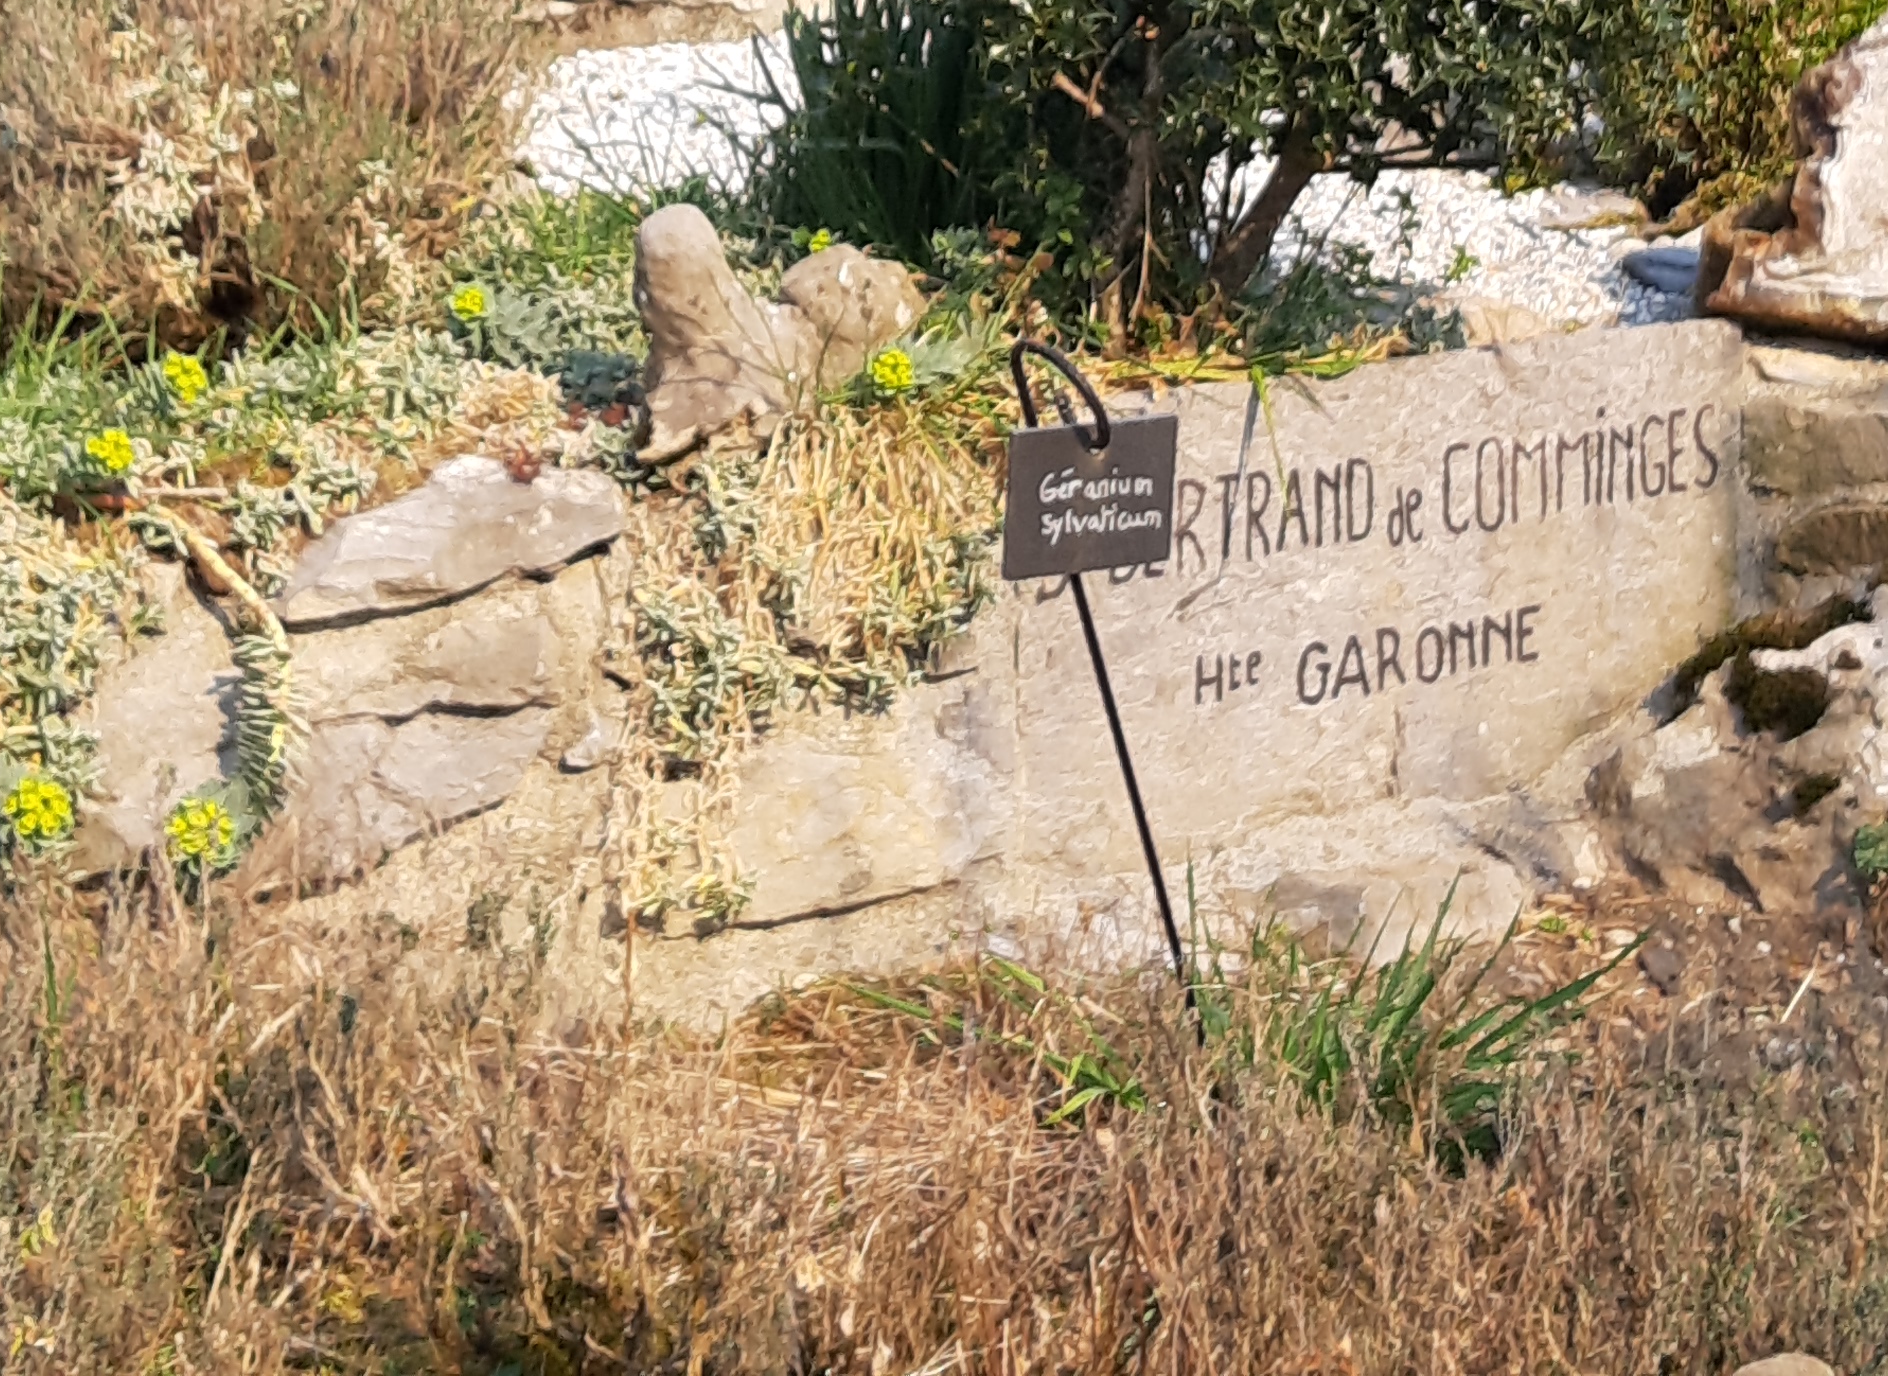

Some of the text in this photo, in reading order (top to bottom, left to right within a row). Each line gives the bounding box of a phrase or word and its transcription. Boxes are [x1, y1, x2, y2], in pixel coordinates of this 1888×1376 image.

[1038, 465, 1154, 504] Géranium
[1108, 457, 1374, 584] RTRAND
[1386, 485, 1424, 548] de
[1295, 604, 1542, 706] GARONNE
